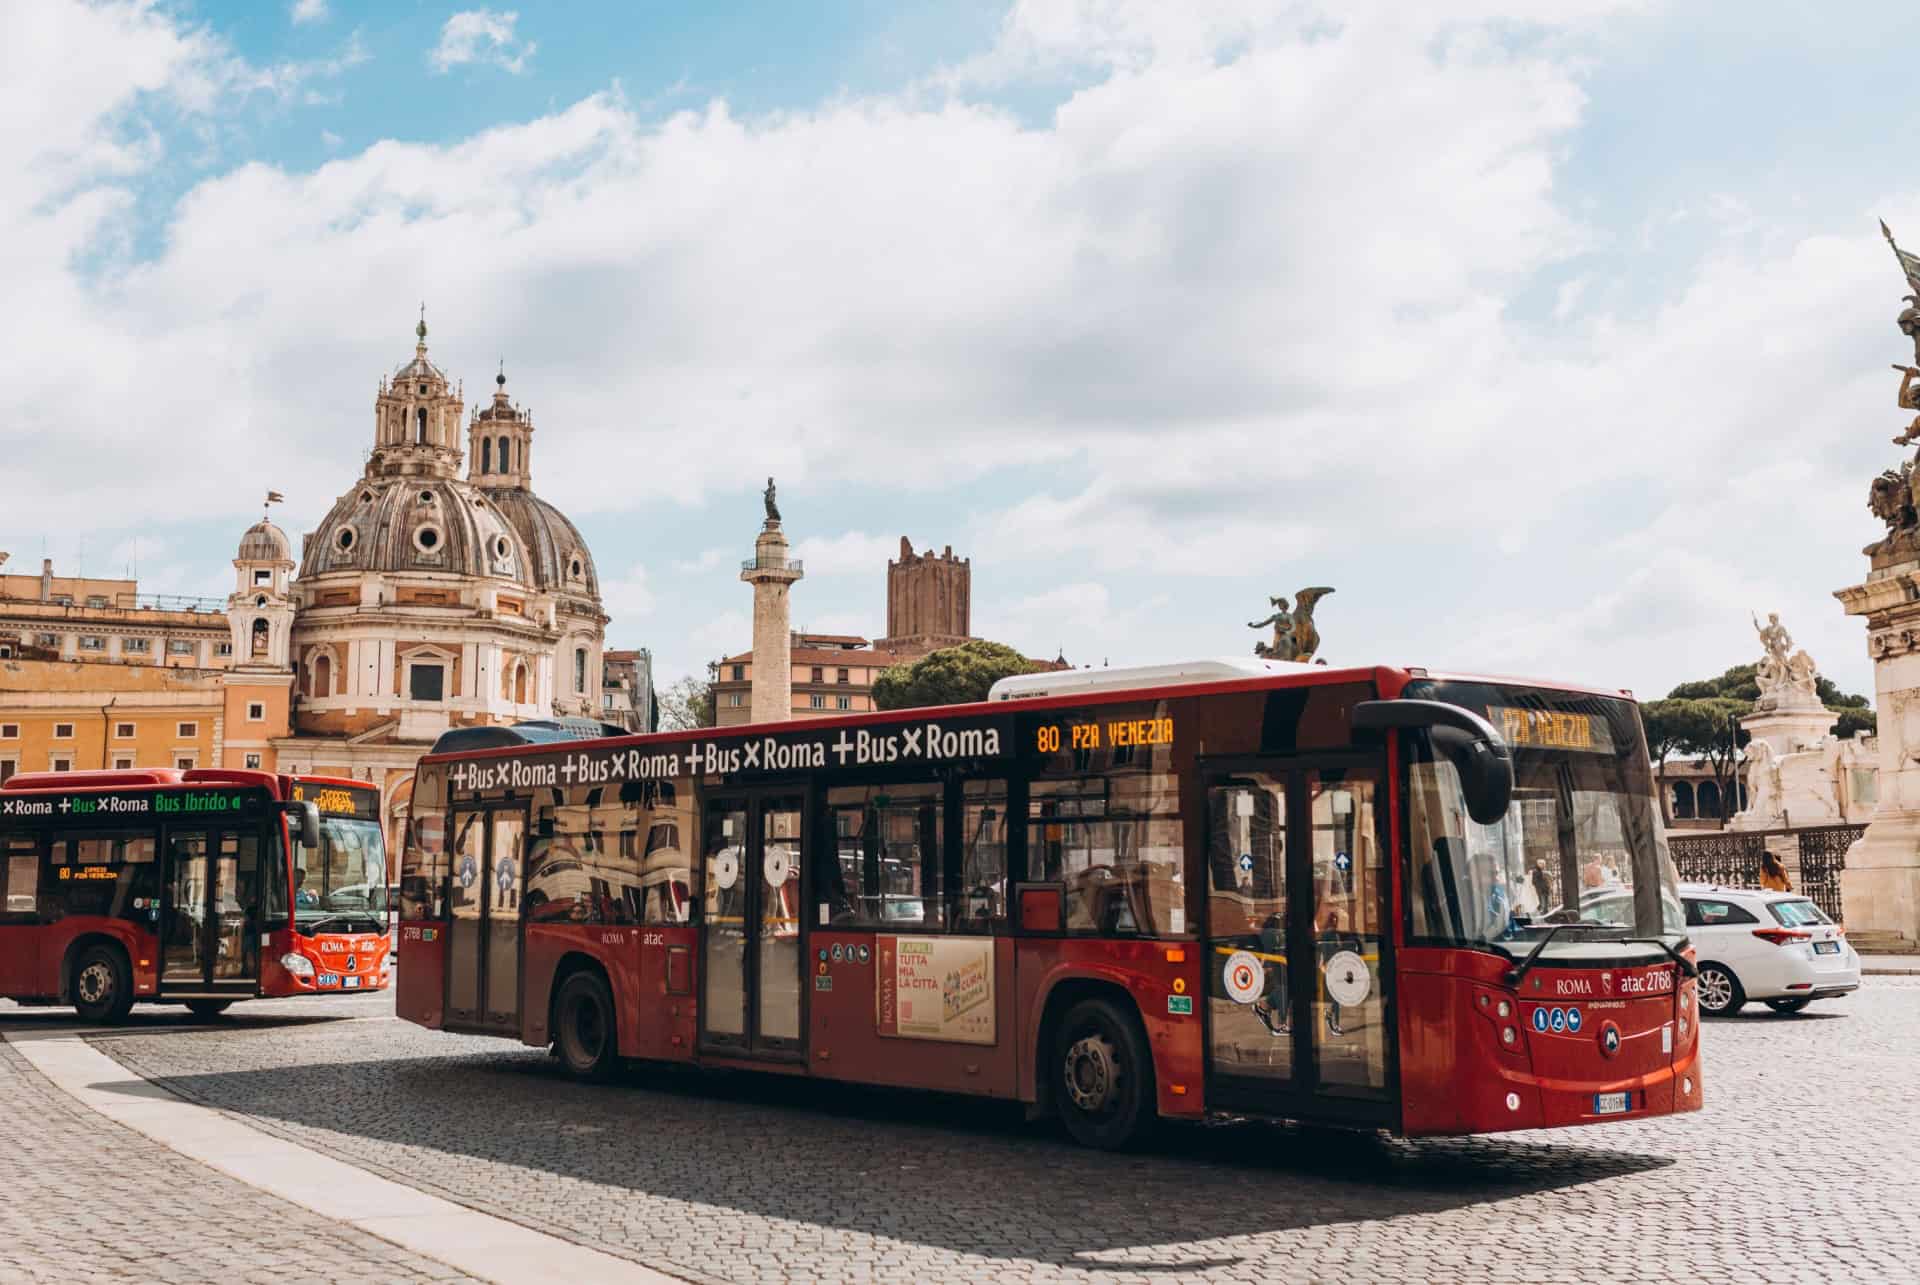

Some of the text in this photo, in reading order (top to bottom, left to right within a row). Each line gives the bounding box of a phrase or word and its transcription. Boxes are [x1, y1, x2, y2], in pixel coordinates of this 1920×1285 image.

[1037, 718, 1173, 752] 80 PZA VENEZIA
[155, 794, 180, 812] Bus
[185, 792, 226, 812] Ibrido
[602, 932, 664, 945] ROMA atac
[899, 955, 928, 965] TUTTA
[899, 978, 910, 989] LA
[1556, 970, 1672, 994] ROMA atac 2768
